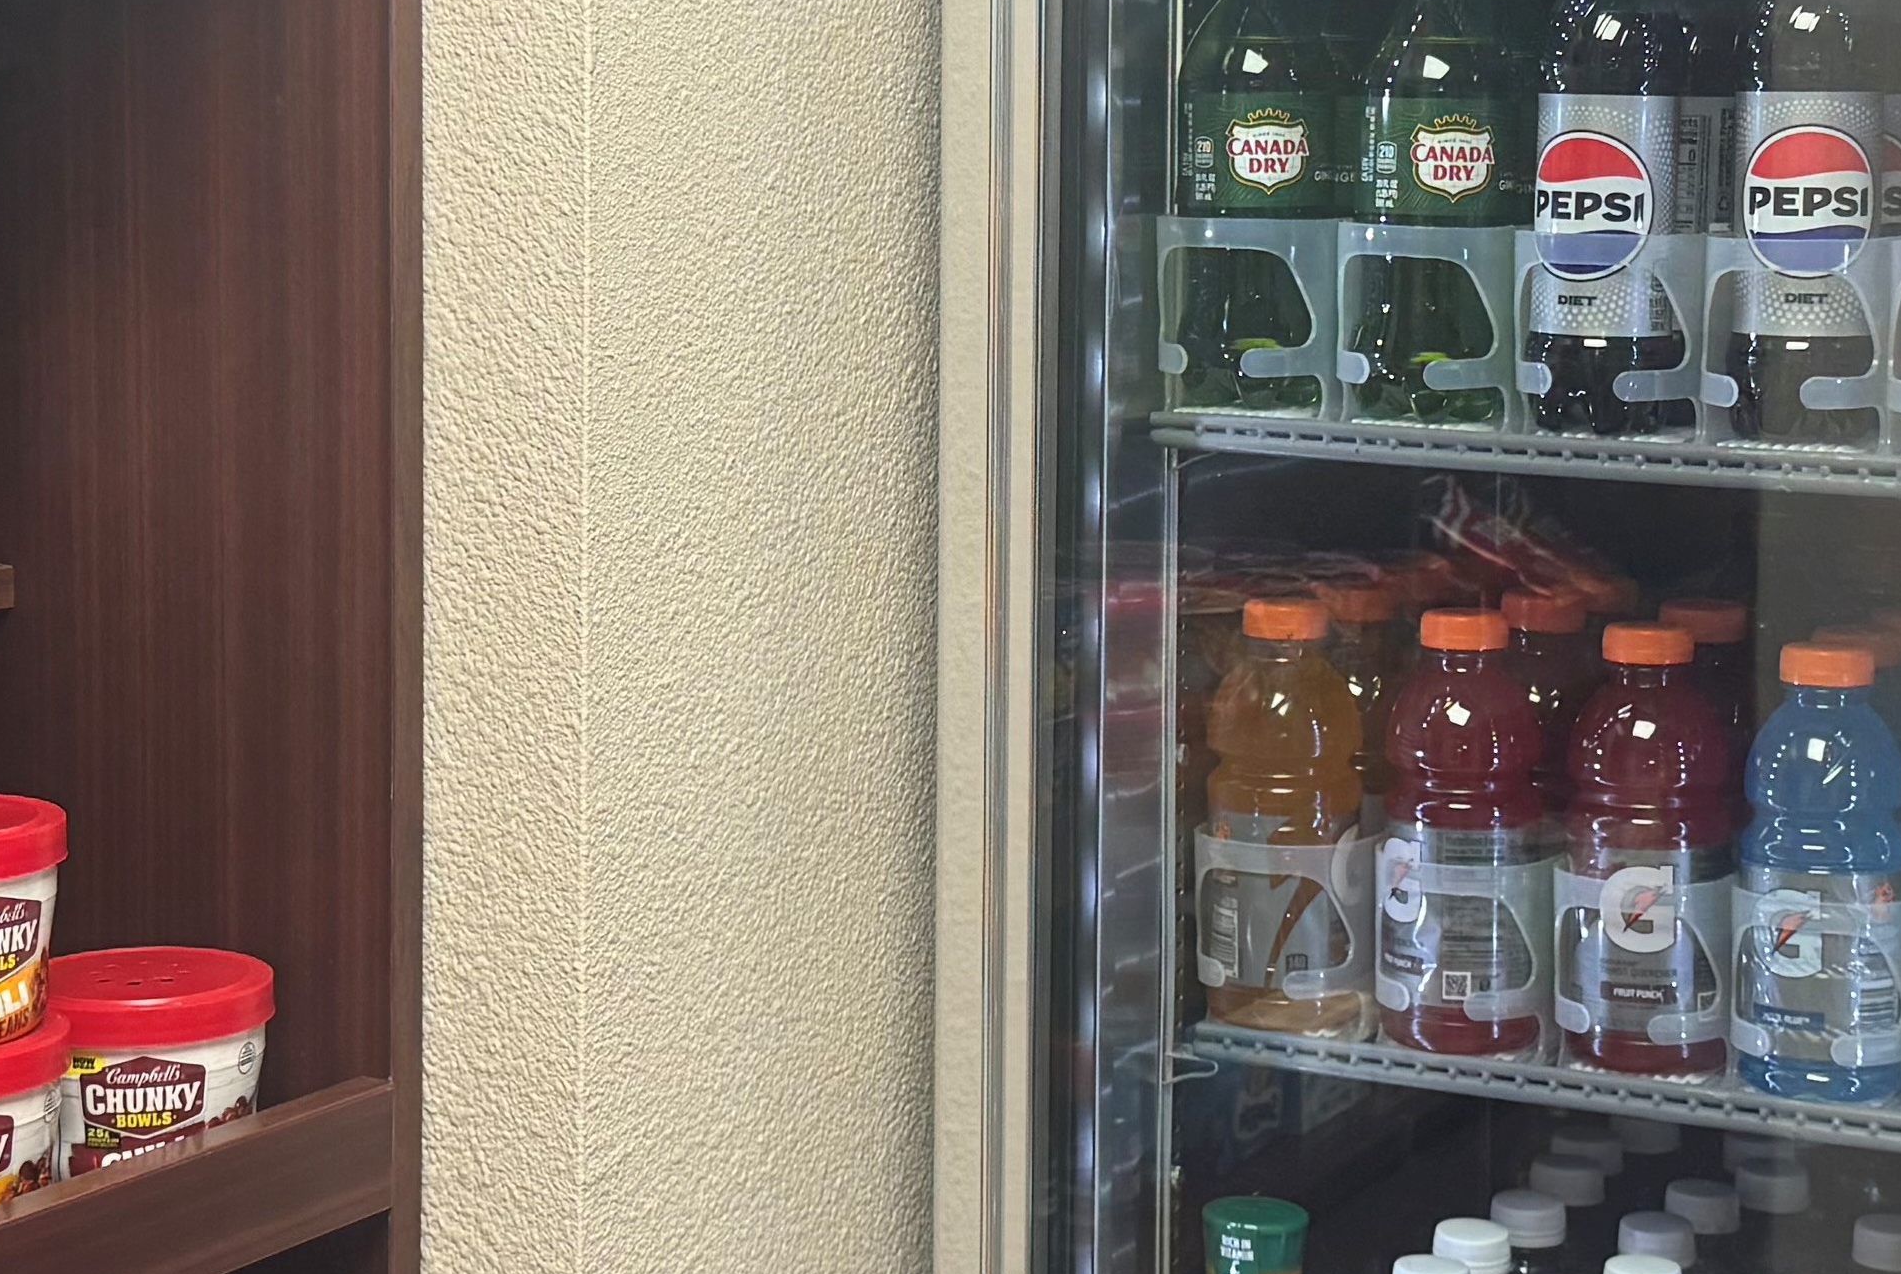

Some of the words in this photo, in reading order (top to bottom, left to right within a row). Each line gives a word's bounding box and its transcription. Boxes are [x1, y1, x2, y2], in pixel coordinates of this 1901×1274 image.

[1226, 138, 1309, 157] CANADA
[1410, 144, 1494, 163] CANADA
[1249, 157, 1289, 174] DRY
[1433, 164, 1475, 181] DRY
[1536, 191, 1645, 221] PEPSI
[1749, 186, 1869, 217] PEPSI
[1558, 295, 1598, 306] DIET
[1784, 293, 1829, 304] DIET
[1613, 988, 1635, 999] FRUIT
[1636, 989, 1664, 1001] PUNCH
